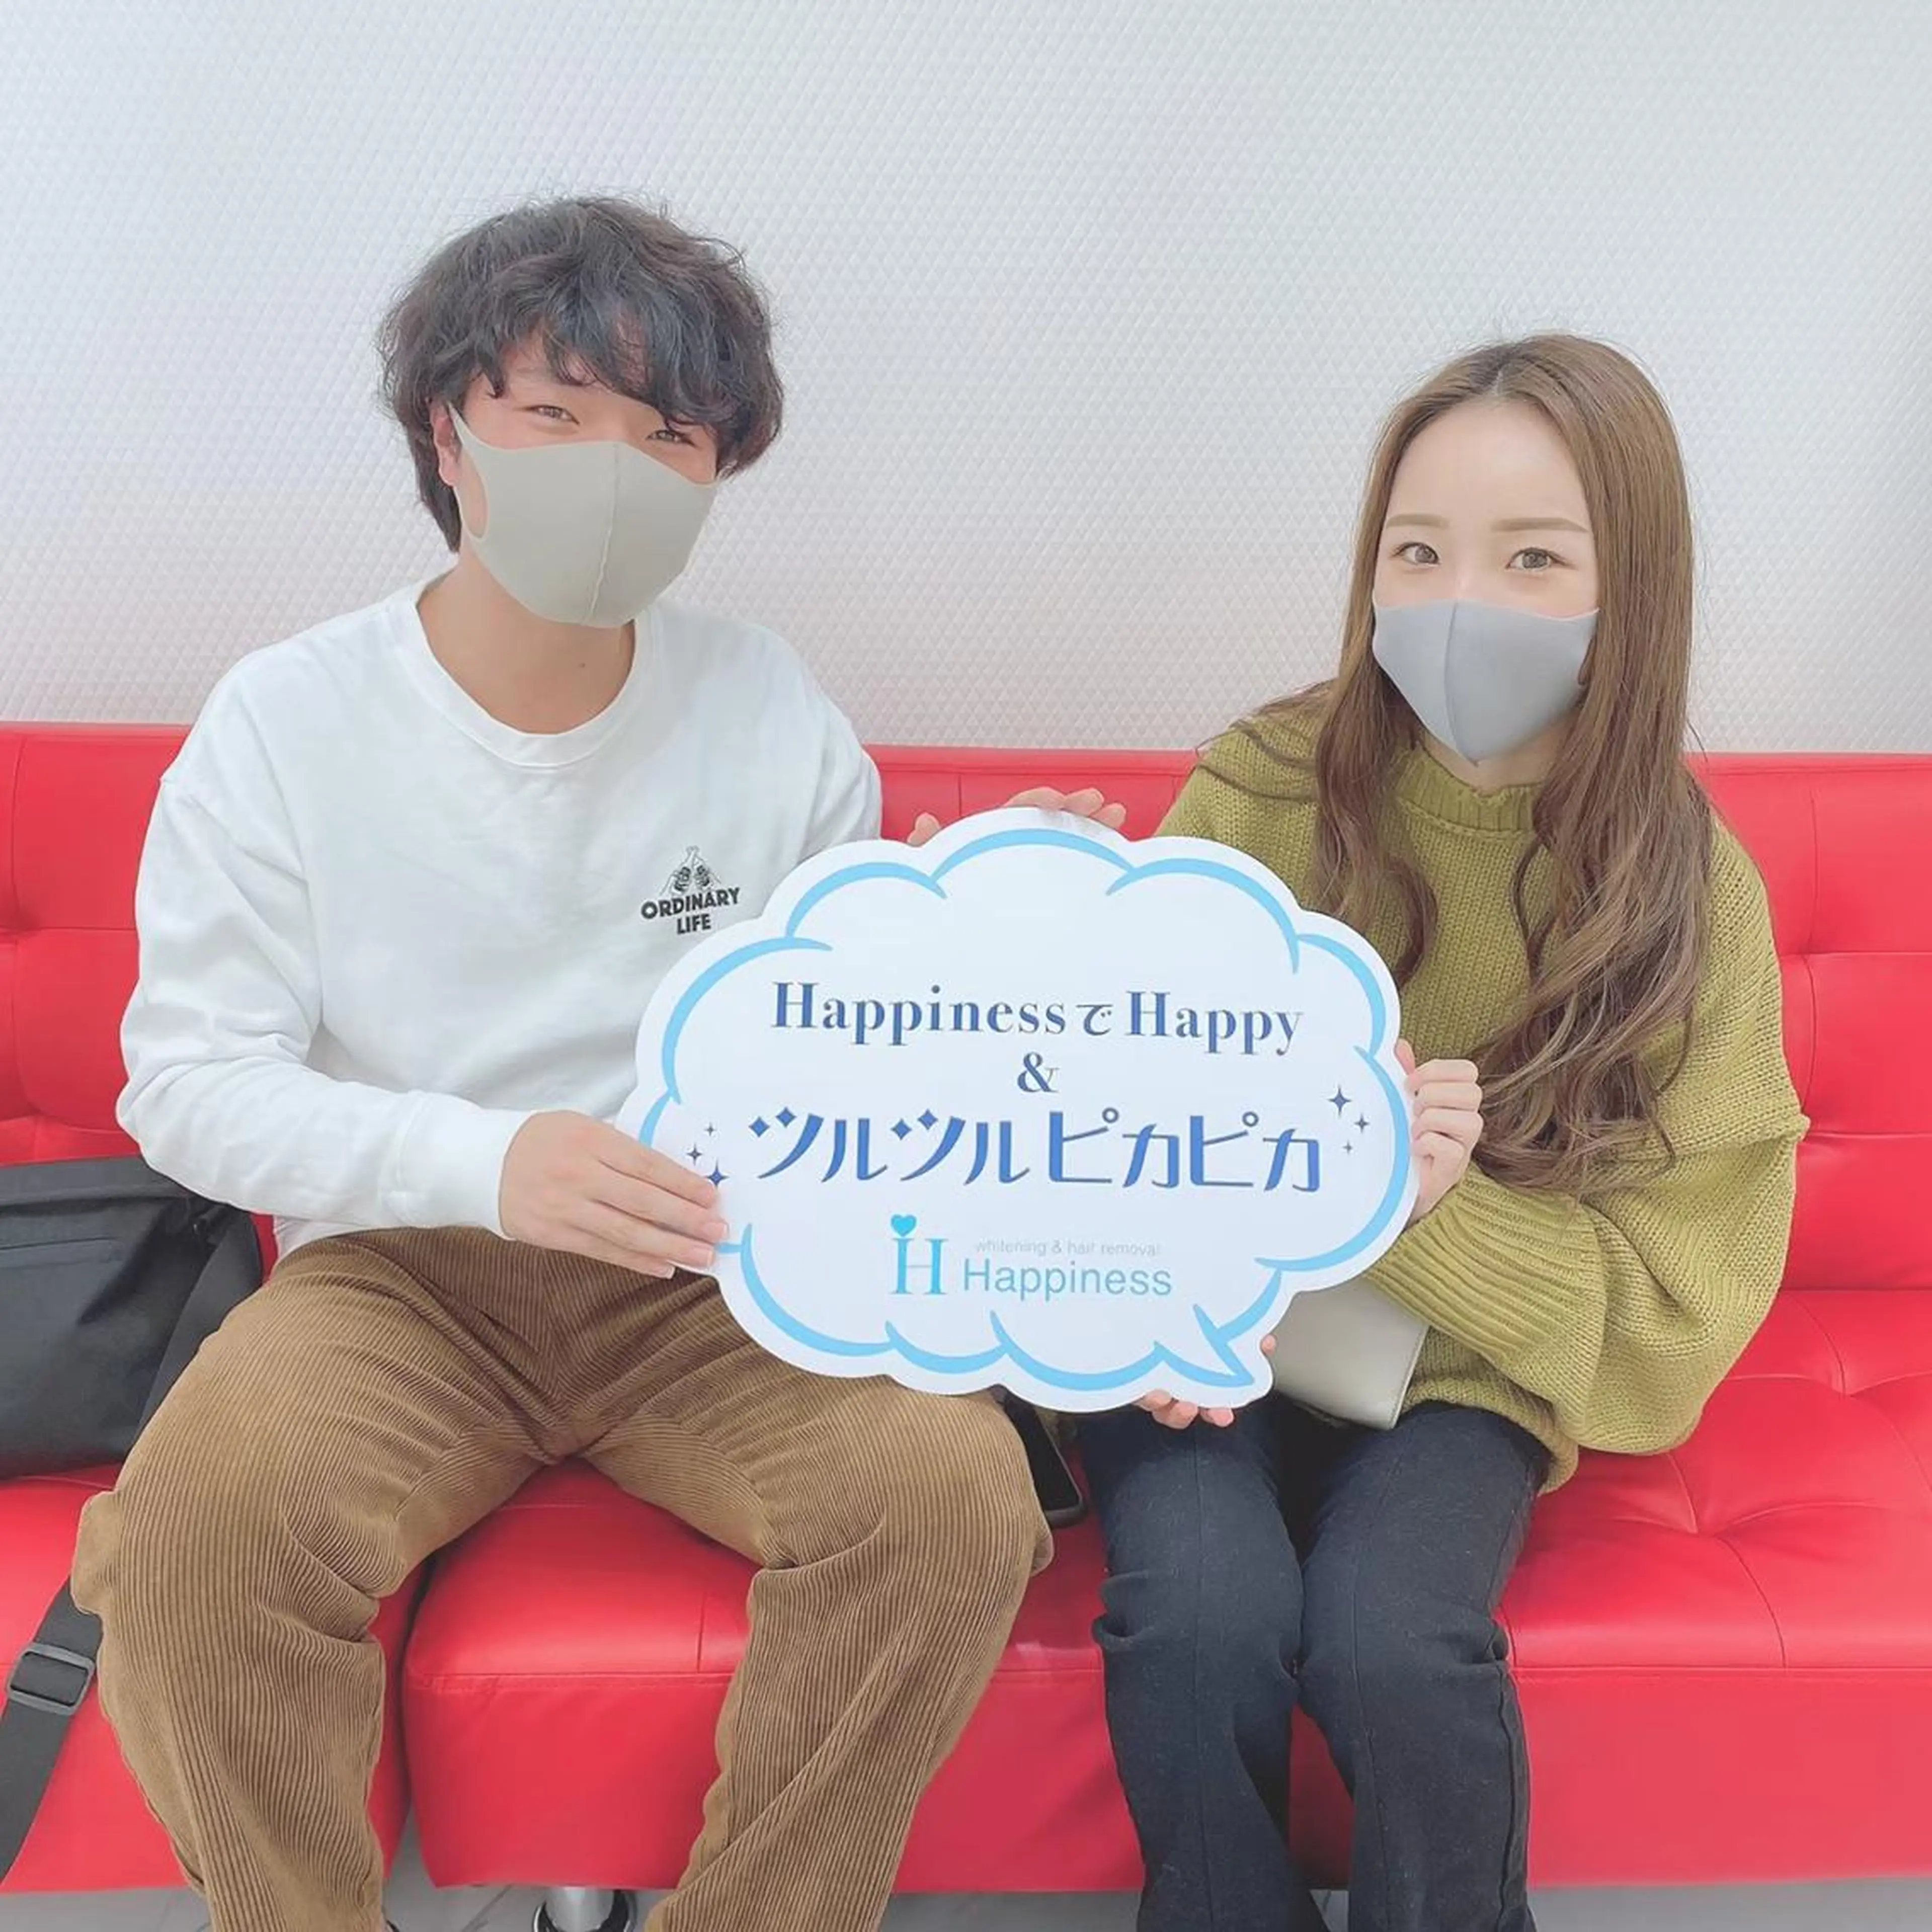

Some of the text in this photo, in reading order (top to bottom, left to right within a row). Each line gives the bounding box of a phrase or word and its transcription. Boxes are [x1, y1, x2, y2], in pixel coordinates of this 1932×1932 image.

[640, 887, 740, 920] ORDINARY
[677, 913, 711, 935] LIFE
[771, 982, 1066, 1046] Happiness
[1124, 990, 1304, 1056] Happy
[1016, 1051, 1059, 1093] &
[975, 1239, 1046, 1256] whitening
[1067, 1240, 1095, 1255] hair
[1100, 1241, 1161, 1256] removal
[963, 1258, 1172, 1303] Happiness
